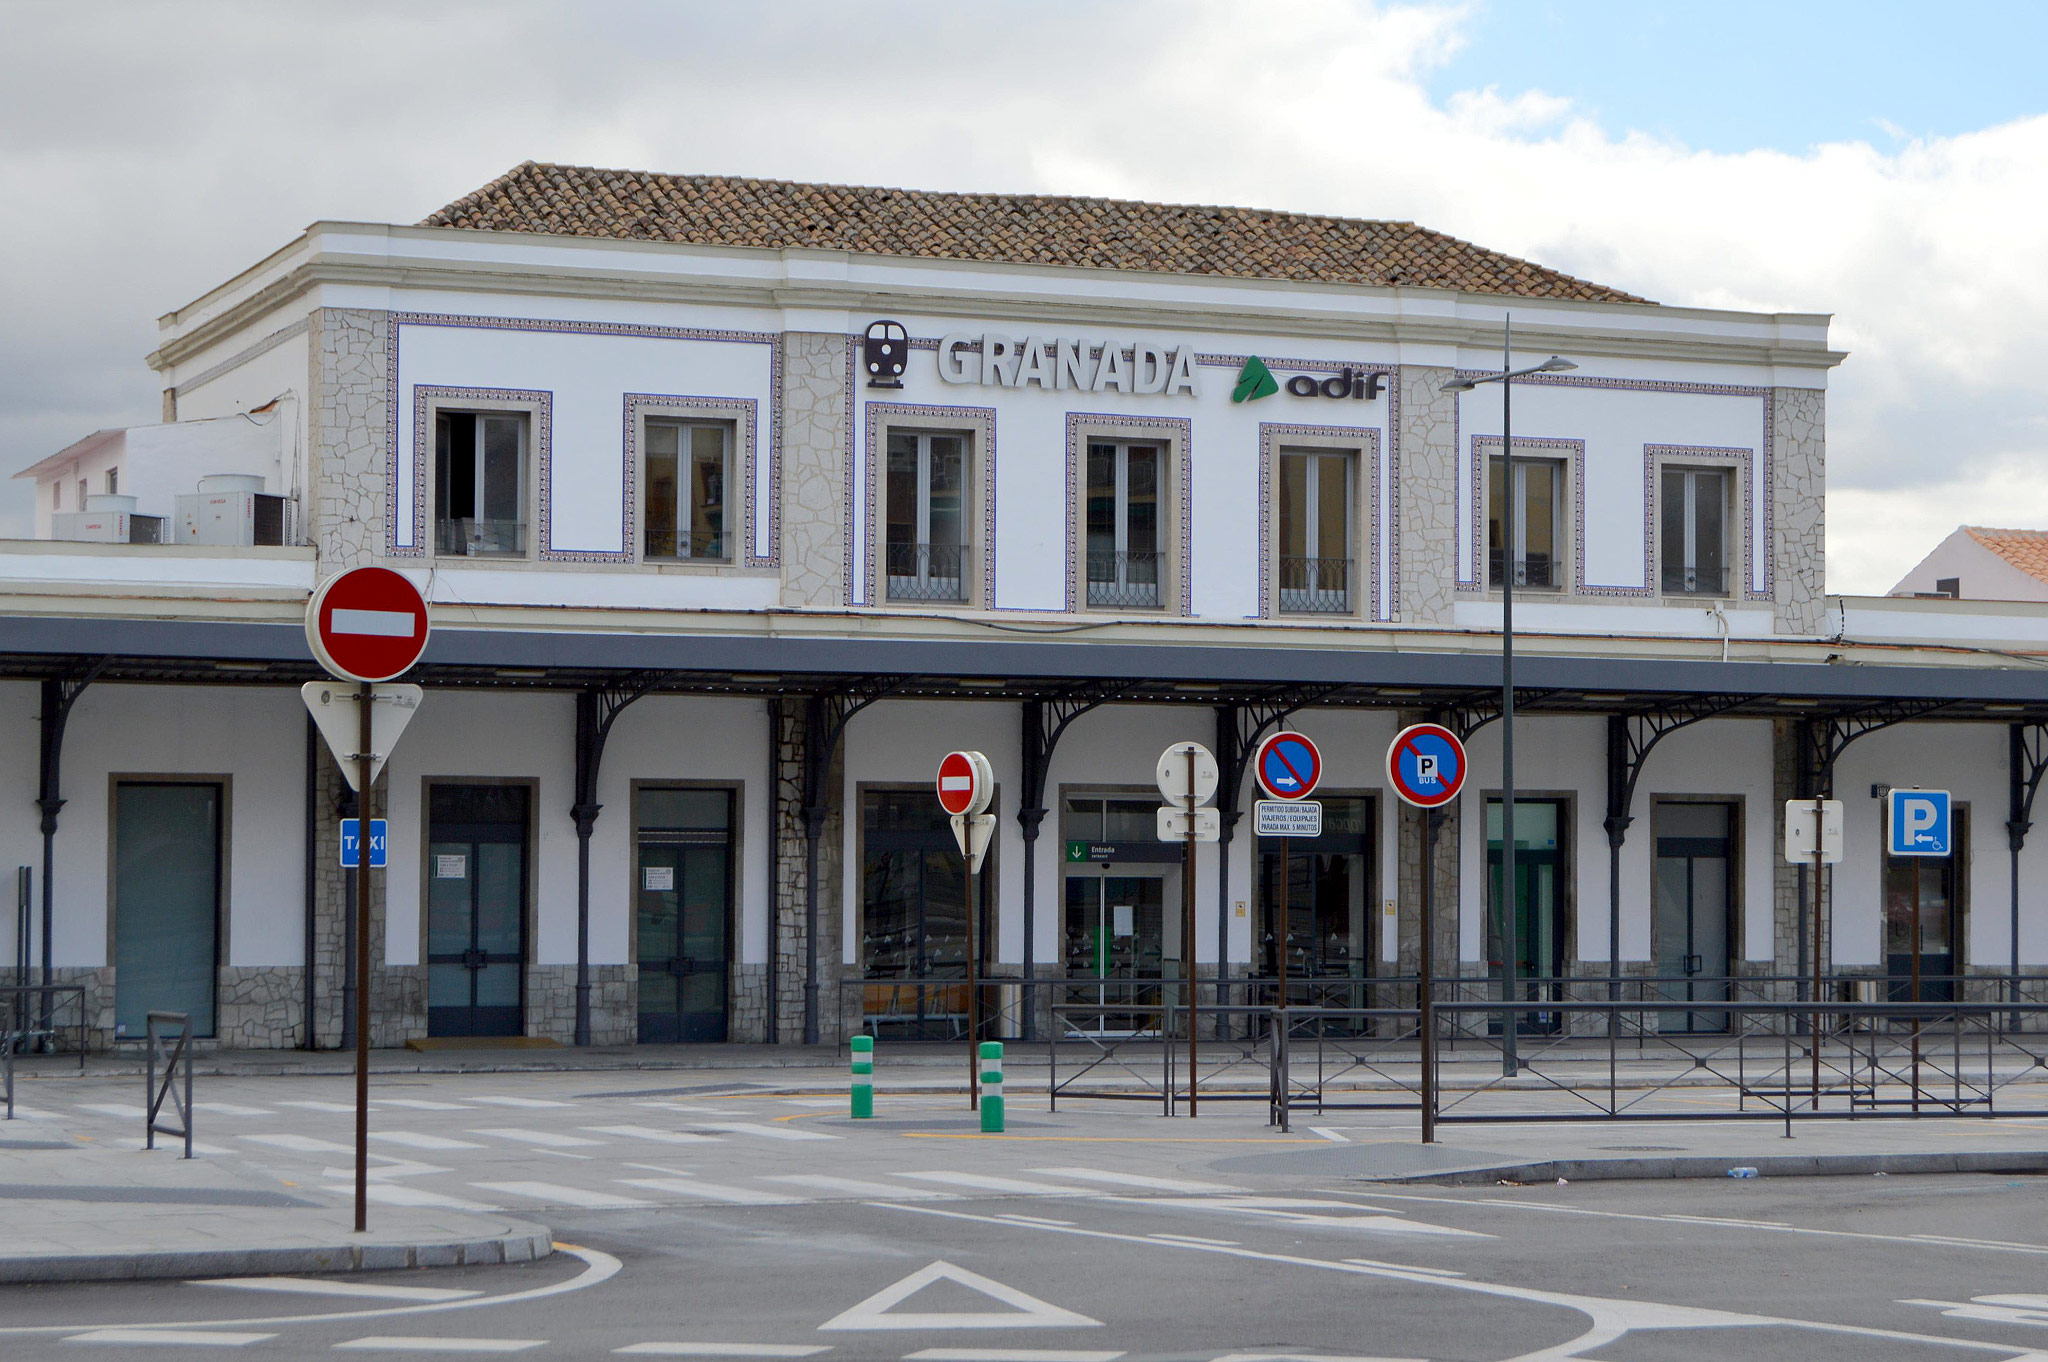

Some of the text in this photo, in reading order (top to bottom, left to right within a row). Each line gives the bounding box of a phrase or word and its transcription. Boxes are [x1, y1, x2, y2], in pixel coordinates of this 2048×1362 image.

[938, 332, 1199, 396] GRANADA
[1285, 368, 1390, 400] adif
[1421, 758, 1433, 774] P
[1261, 805, 1284, 813] PERMITIDO
[1904, 799, 1937, 845] P
